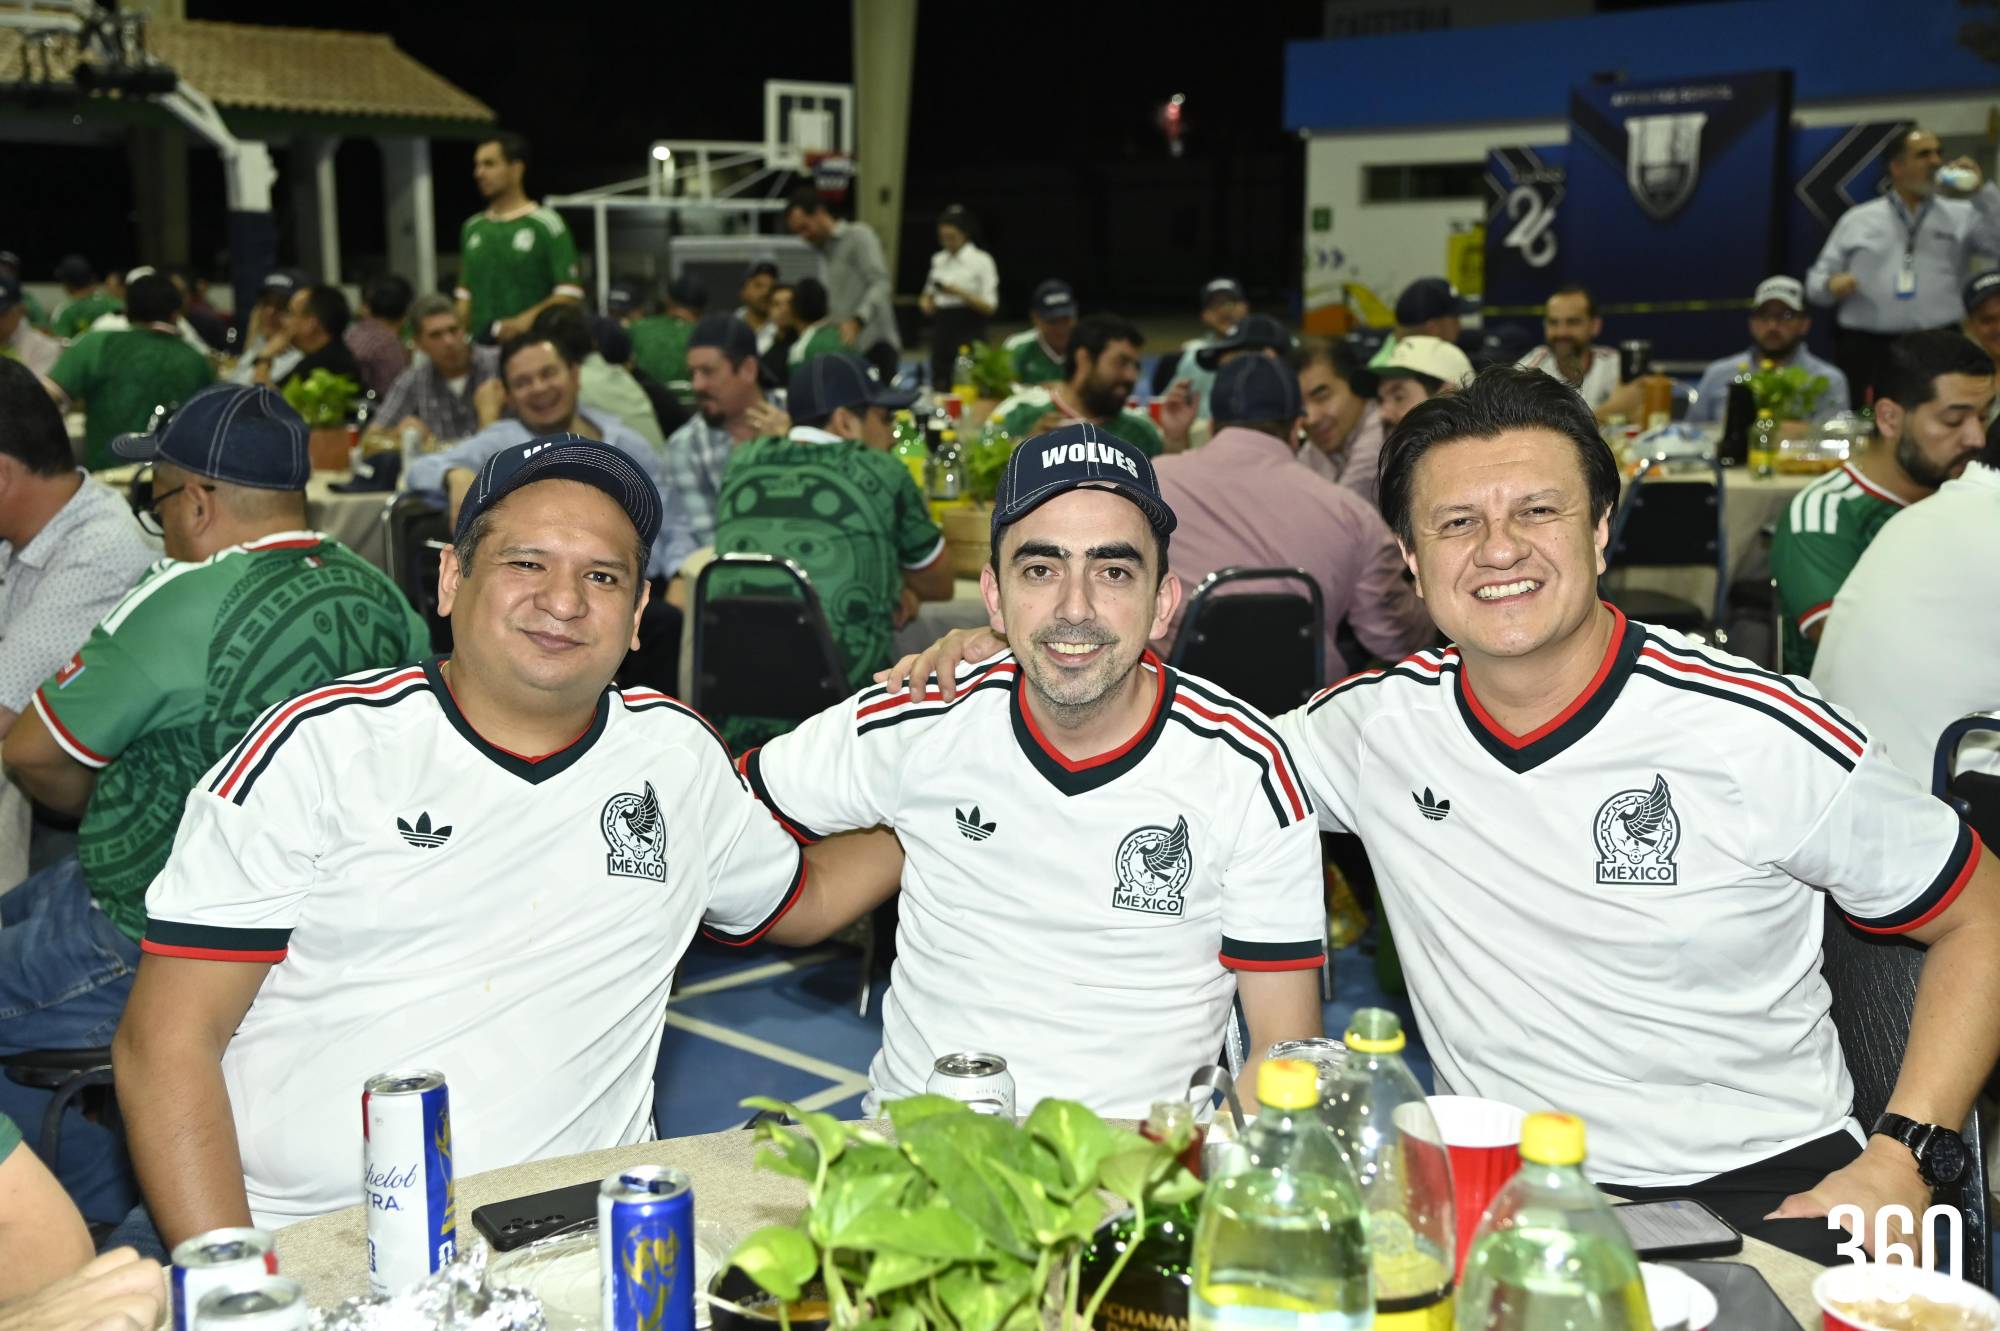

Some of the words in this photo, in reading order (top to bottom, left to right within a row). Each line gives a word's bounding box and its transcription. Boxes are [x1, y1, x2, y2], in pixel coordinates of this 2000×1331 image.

[1041, 441, 1139, 479] WOLVES
[611, 857, 663, 878] MÉXICO
[1602, 862, 1672, 881] MÉXICO
[1117, 893, 1179, 912] MÉXICO
[364, 1162, 418, 1189] helob
